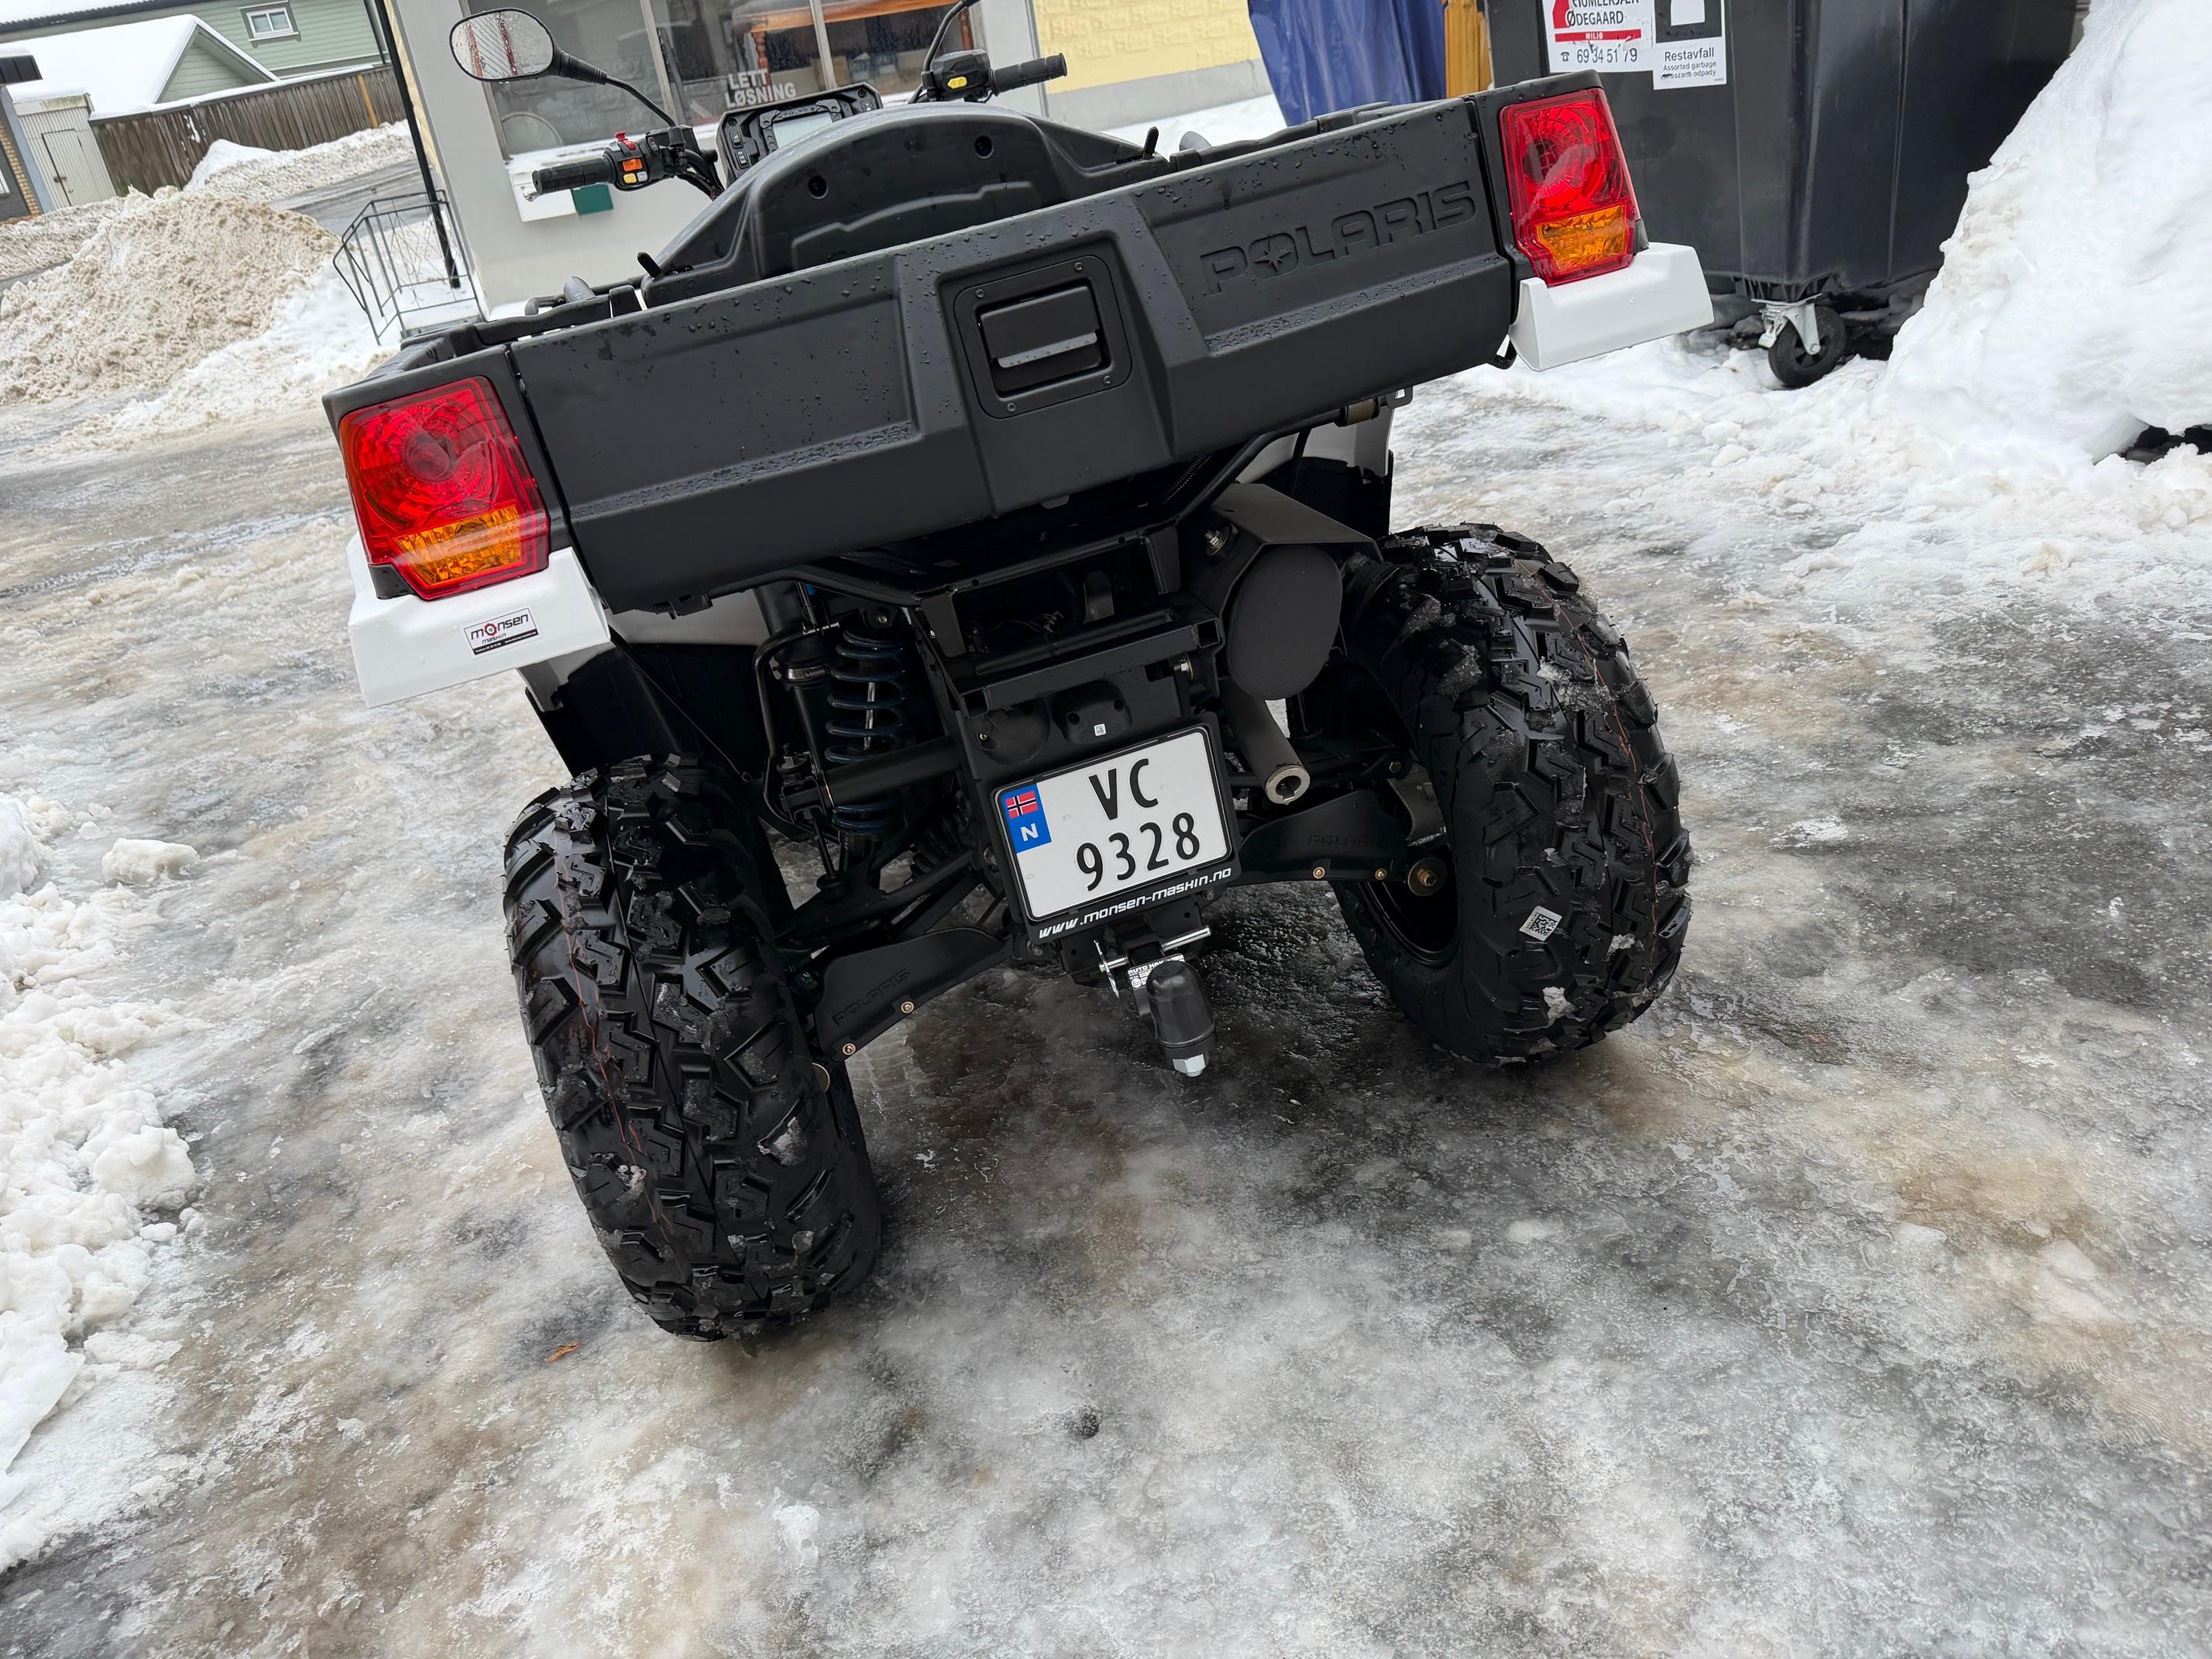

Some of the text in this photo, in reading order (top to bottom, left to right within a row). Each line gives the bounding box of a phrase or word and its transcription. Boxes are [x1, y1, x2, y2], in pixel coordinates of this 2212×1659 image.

[1566, 10, 1624, 26] ØDEGAARD
[1577, 49, 1589, 63] 69
[1592, 48, 1603, 62] 34
[1606, 48, 1617, 62] 51
[1664, 47, 1714, 61] Restavfall
[729, 68, 768, 90] LETT
[1663, 63, 1690, 71] Assorted
[725, 82, 796, 108] LØSNING
[1200, 180, 1475, 296] POLARIS
[471, 614, 528, 640] monsen
[1088, 757, 1159, 820] VC
[1021, 823, 1039, 842] N
[1076, 812, 1201, 892] 9328
[832, 968, 911, 1026] POLARIS
